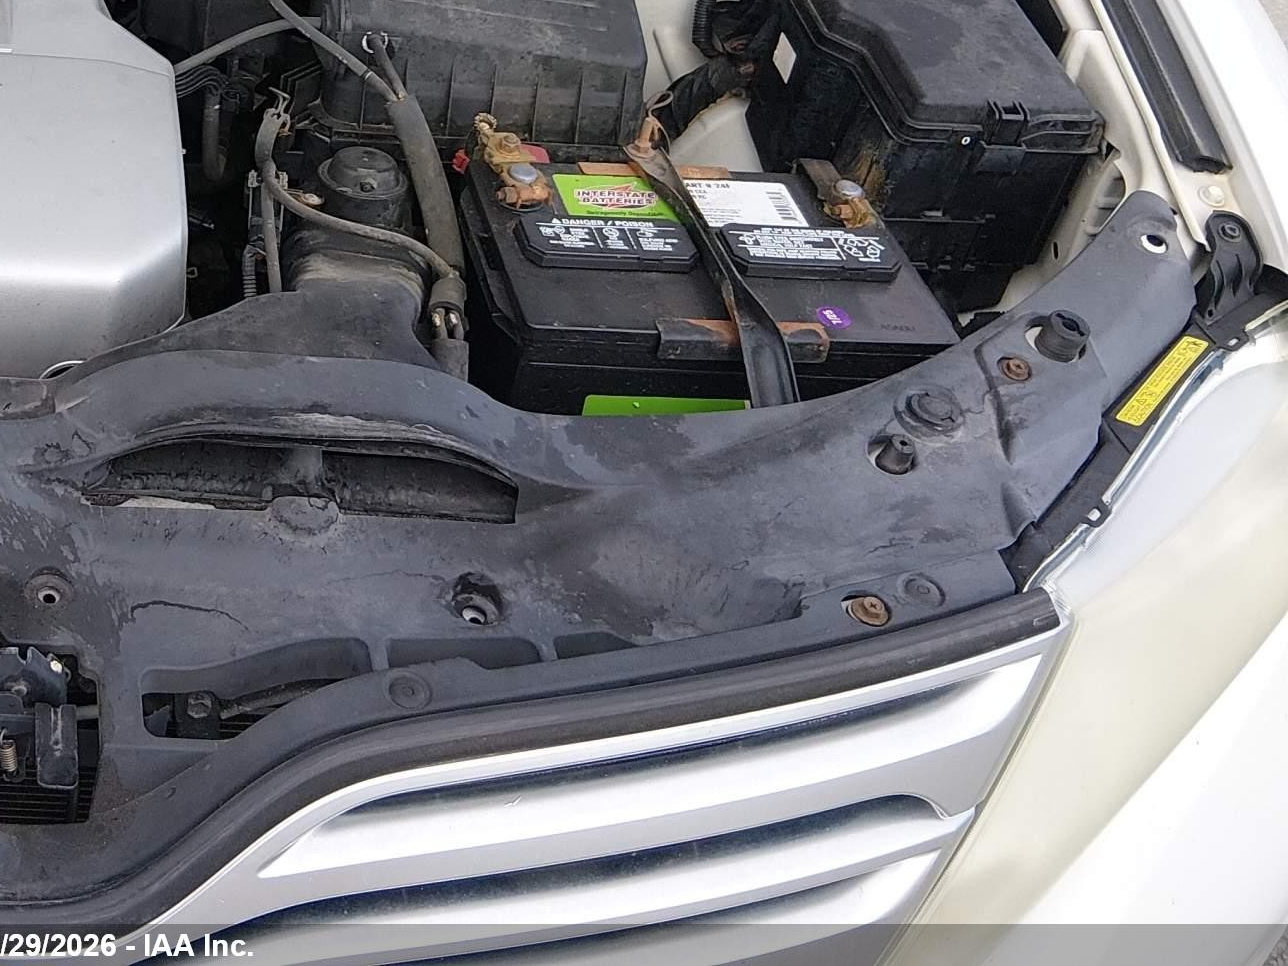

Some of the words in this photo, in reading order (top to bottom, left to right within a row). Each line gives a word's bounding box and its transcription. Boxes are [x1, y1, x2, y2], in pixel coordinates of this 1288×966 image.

[576, 190, 656, 199] INTERSTATE
[581, 197, 654, 205] BATTERIES
[615, 220, 654, 228] POISON
